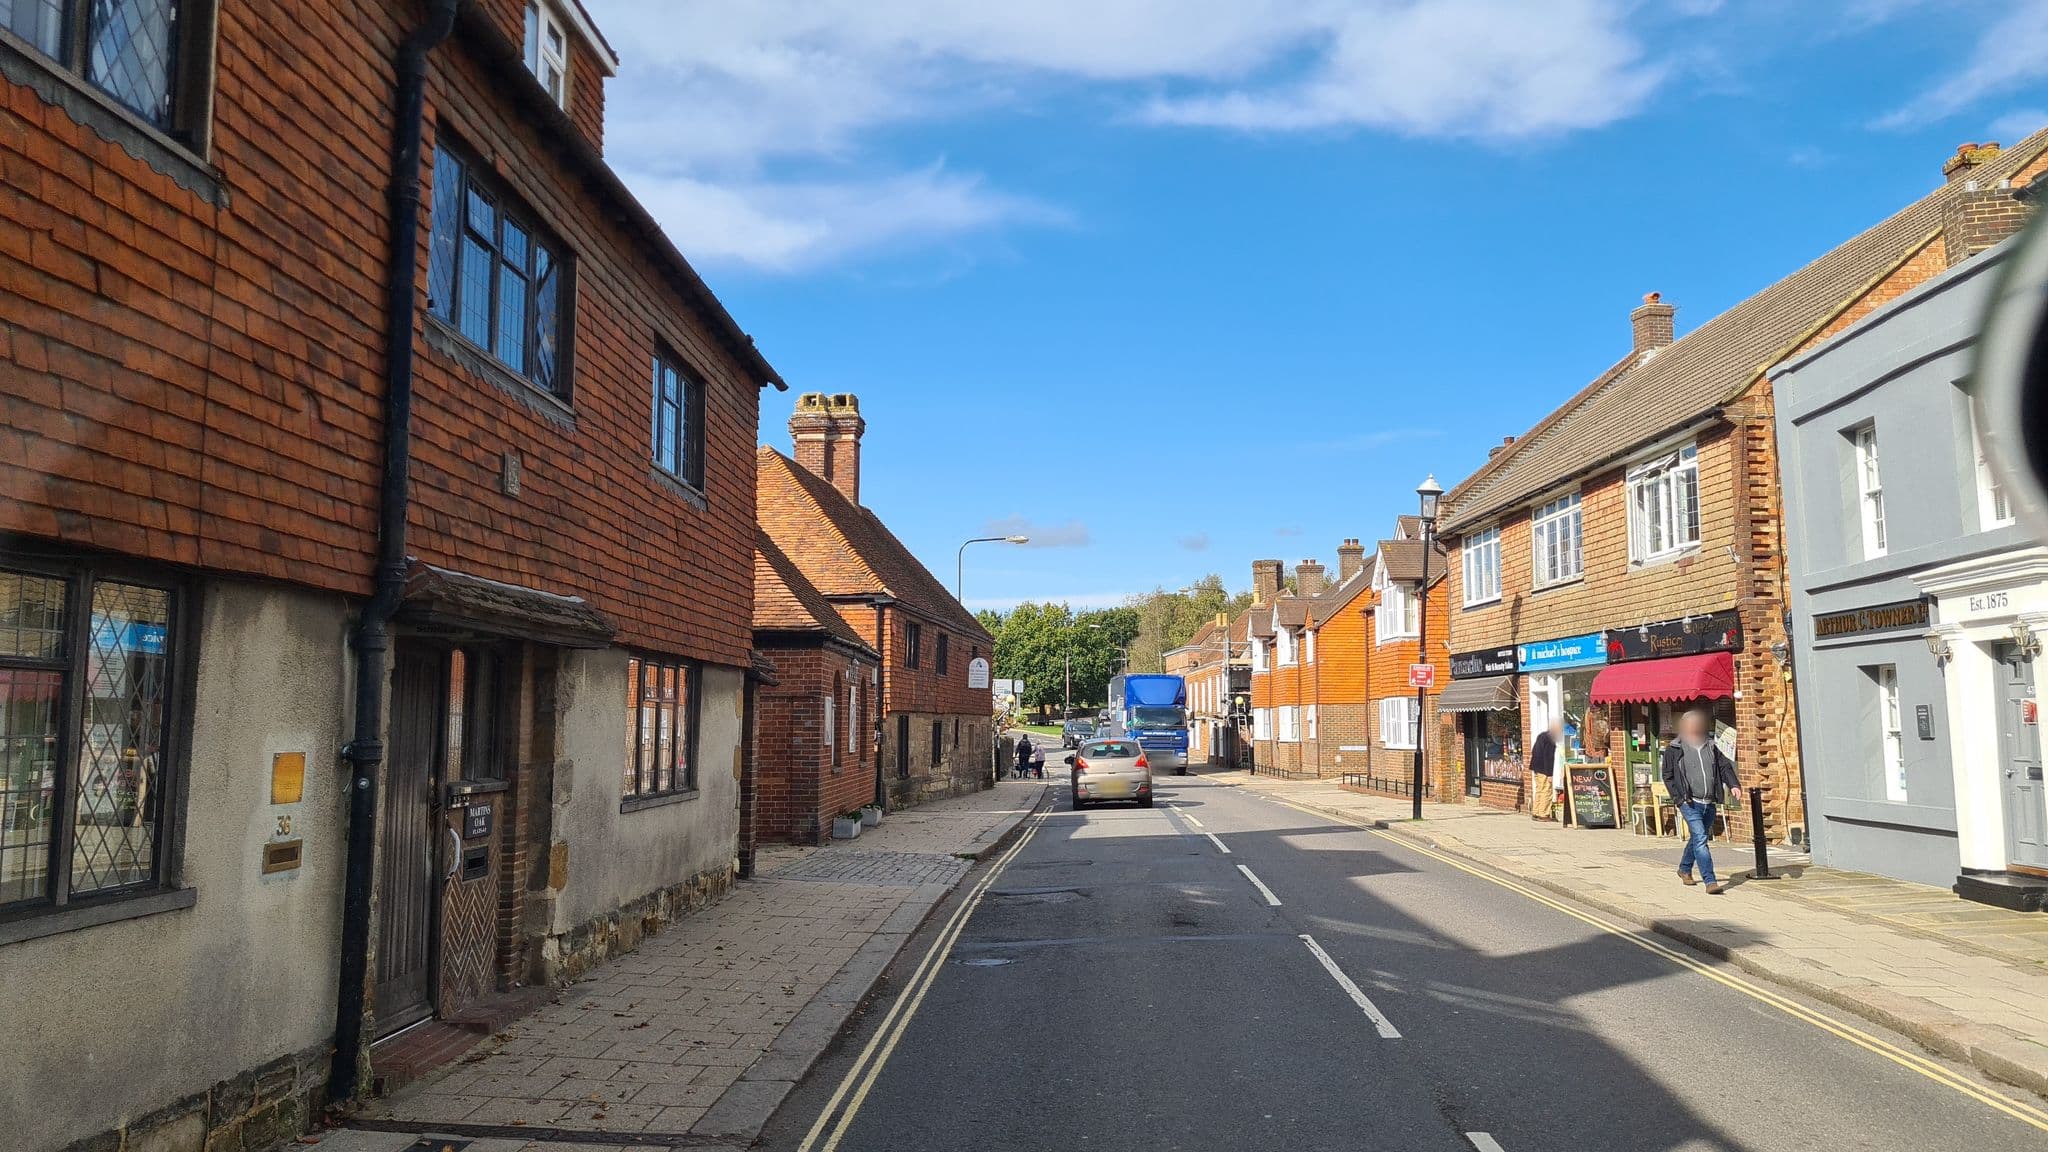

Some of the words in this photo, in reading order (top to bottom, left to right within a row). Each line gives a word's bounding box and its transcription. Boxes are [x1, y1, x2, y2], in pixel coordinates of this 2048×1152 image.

[1969, 597, 1986, 611] Est.
[1986, 592, 2009, 609] 1875
[1815, 613, 1857, 636] ARTHUR
[1572, 775, 1592, 783] NEW
[469, 805, 491, 817] MARTINS
[276, 815, 292, 836] 36
[474, 817, 486, 827] OAK
